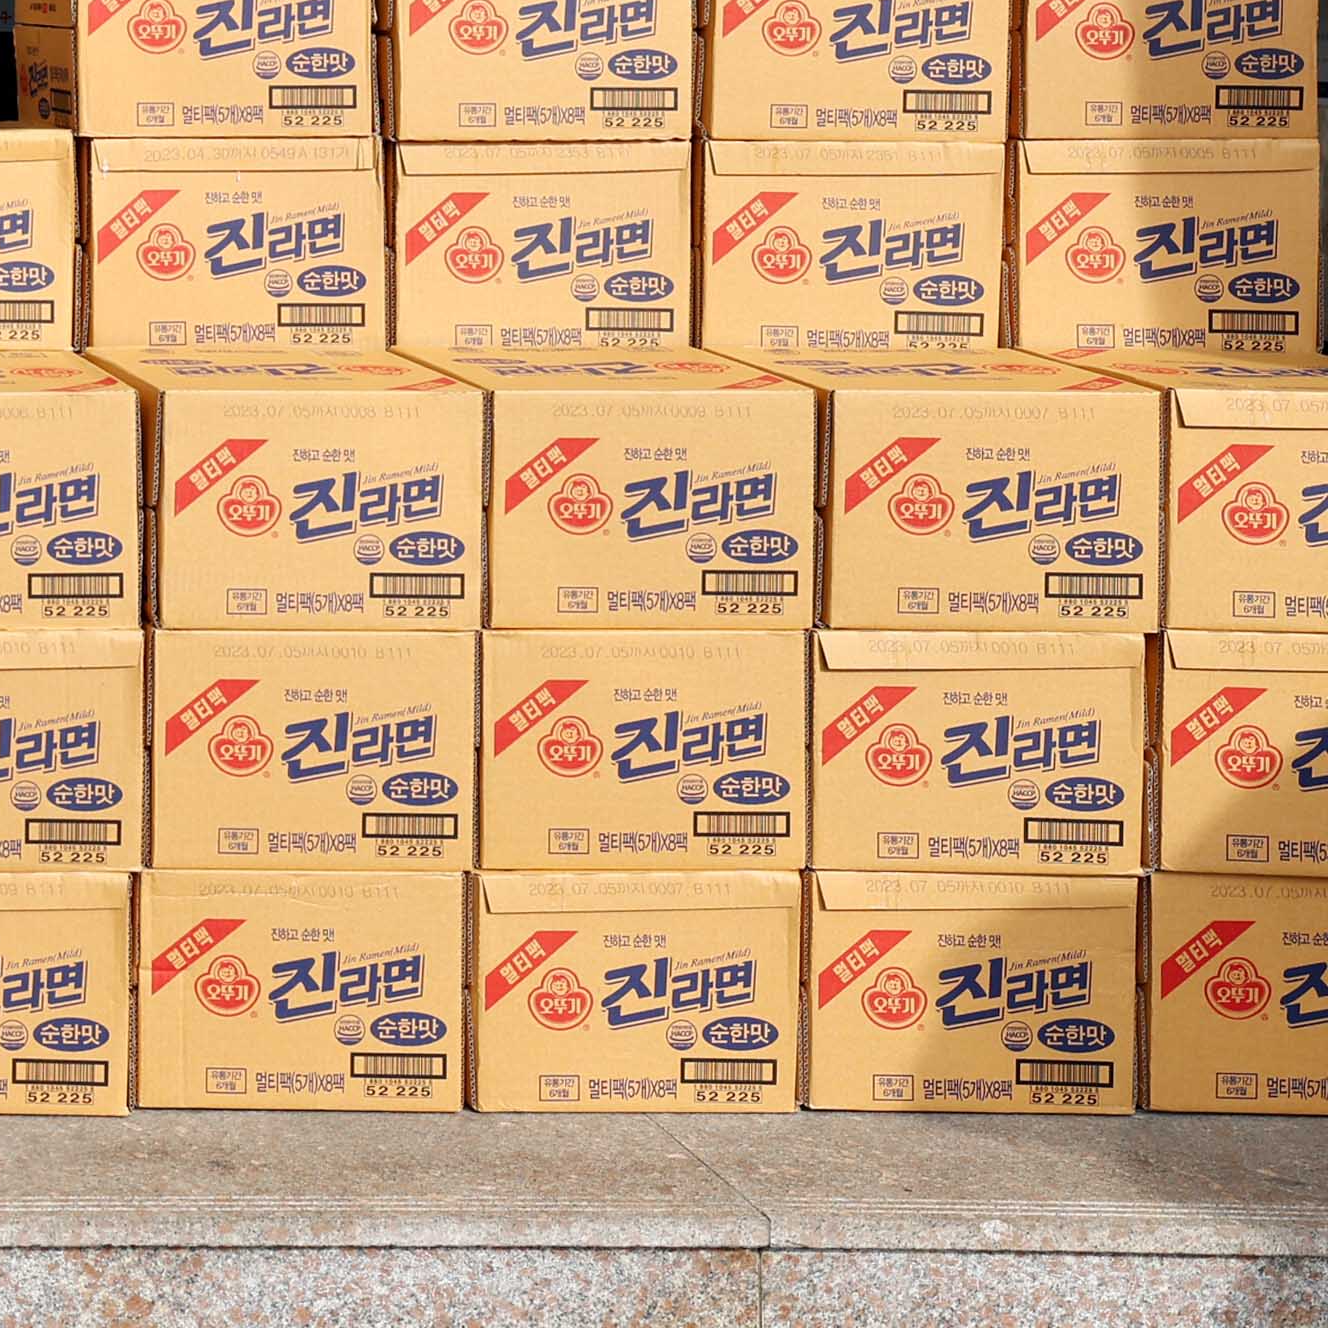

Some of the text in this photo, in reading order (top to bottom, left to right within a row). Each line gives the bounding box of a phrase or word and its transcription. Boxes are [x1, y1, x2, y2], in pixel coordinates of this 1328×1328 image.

[203, 205, 349, 282] 진라면
[511, 216, 654, 284] 진라면
[820, 217, 967, 287] 진라면
[1133, 215, 1279, 285] 진라면
[289, 470, 444, 546] 진라면
[621, 468, 777, 544] 진라면
[962, 469, 1122, 546] 진라면
[281, 710, 437, 786] 진라면
[611, 710, 768, 784] 진라면
[941, 714, 1102, 792] 진라면
[269, 949, 425, 1026] 진라면
[601, 956, 758, 1031] 진라면
[936, 956, 1093, 1033] 진라면
